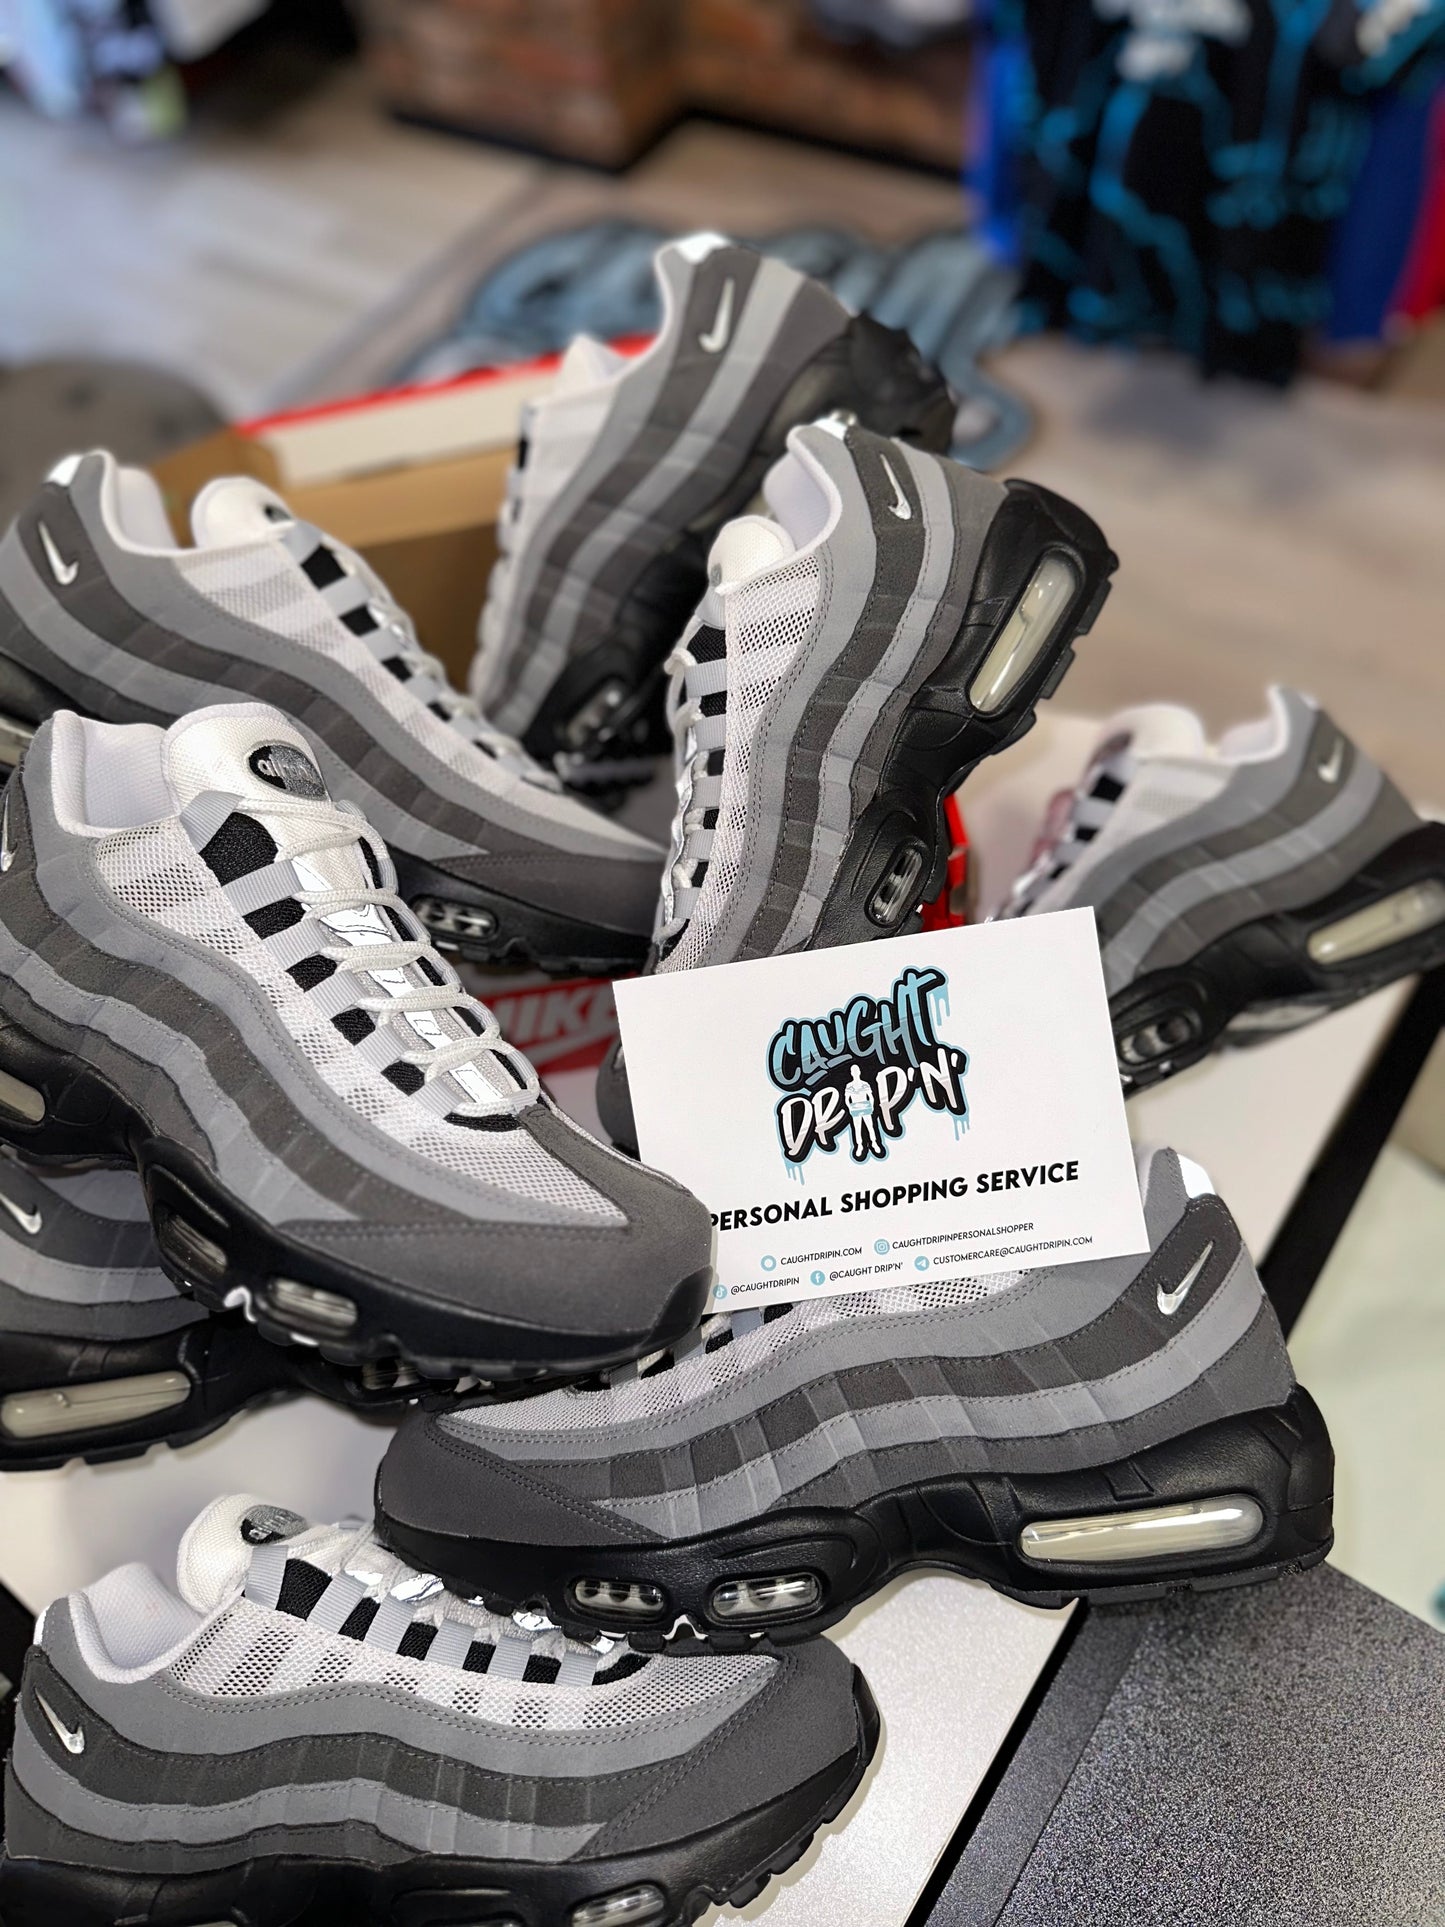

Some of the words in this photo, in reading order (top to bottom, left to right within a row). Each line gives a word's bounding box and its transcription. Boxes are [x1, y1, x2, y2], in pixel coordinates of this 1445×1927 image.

[771, 970, 939, 1086] CAUGHT
[840, 1176, 968, 1214] SHOPPING
[976, 1160, 1079, 1194] SERVICE
[892, 1222, 1034, 1250] CAUGHTDRIPINPERSONALSHOPPER
[780, 1246, 863, 1266] CAUGHTDRIPIN.COM
[932, 1235, 1094, 1266] CUSTOMERCARE@CAUGHTDRIPIN.COM
[730, 1276, 800, 1296] @CAUGHTDRIPIN
[829, 1266, 873, 1282] @CAUGHT
